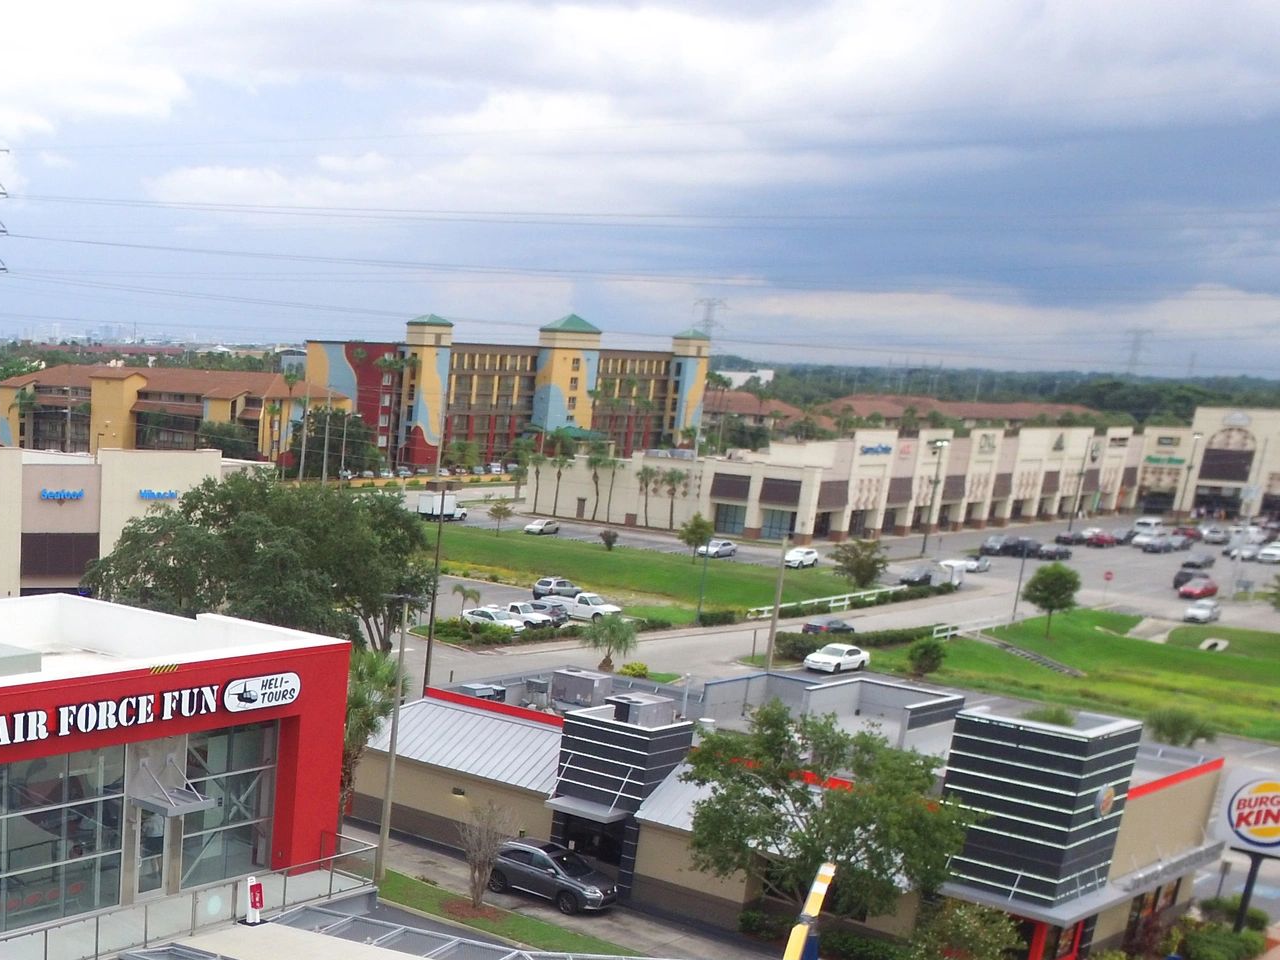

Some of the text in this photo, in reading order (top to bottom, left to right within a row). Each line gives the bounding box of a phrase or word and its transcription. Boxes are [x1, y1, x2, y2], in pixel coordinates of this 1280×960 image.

[261, 678, 290, 691] HELI-
[261, 690, 297, 704] TOURS
[58, 694, 155, 737] FORCE
[161, 685, 220, 722] FUN
